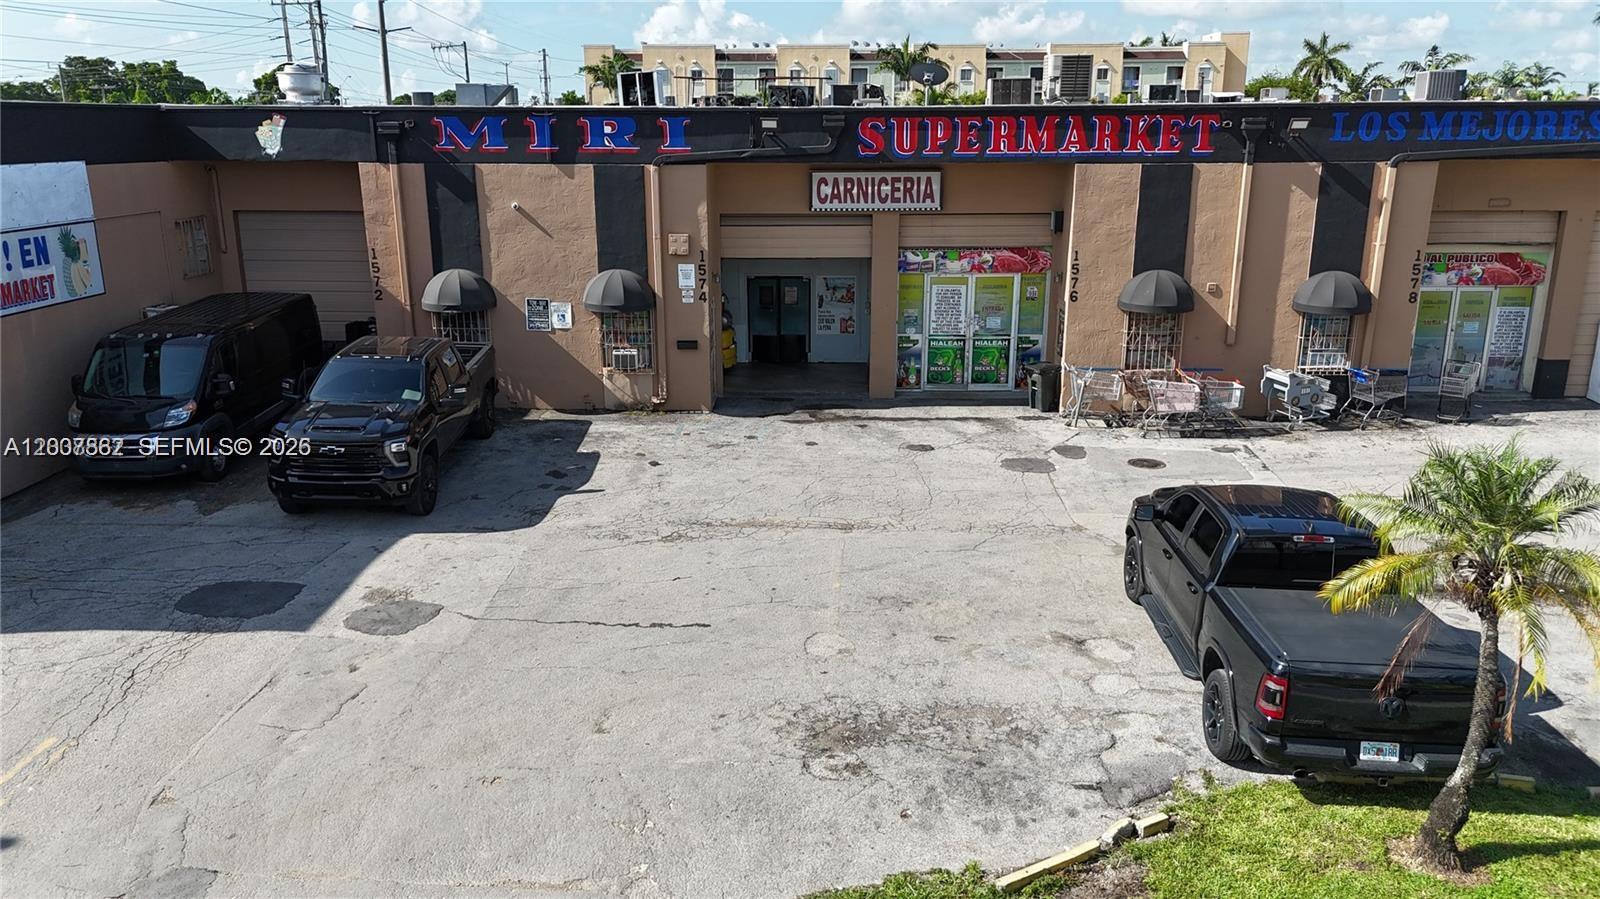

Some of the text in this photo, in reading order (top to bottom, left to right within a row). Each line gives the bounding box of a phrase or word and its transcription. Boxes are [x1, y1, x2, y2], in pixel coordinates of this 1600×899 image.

[431, 113, 1221, 158] MIRI SUPERMARKET
[1329, 110, 1411, 143] LOS
[816, 175, 936, 206] CARNICERIA
[18, 235, 51, 269] EN
[1447, 253, 1496, 264] PUBLICO
[0, 273, 56, 309] MARKET
[370, 247, 384, 301] 1572
[698, 250, 707, 303] 1574
[1069, 250, 1080, 303] 1576
[1408, 249, 1422, 304] 1578
